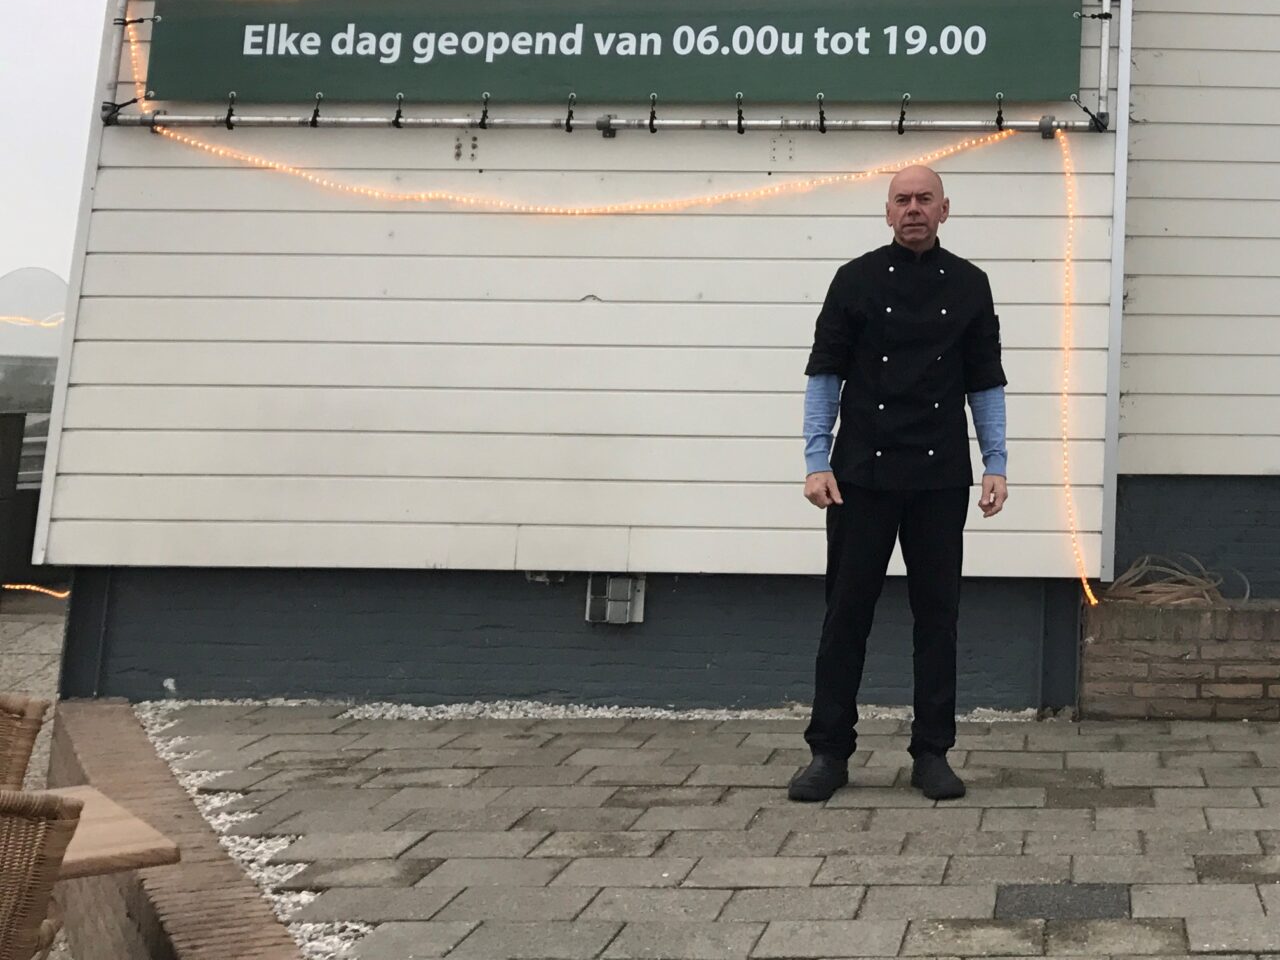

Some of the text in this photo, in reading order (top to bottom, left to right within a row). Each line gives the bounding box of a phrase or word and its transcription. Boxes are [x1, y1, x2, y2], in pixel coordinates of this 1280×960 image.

[242, 22, 989, 65] Elke dag geopend van 06.00u tot 19.00
